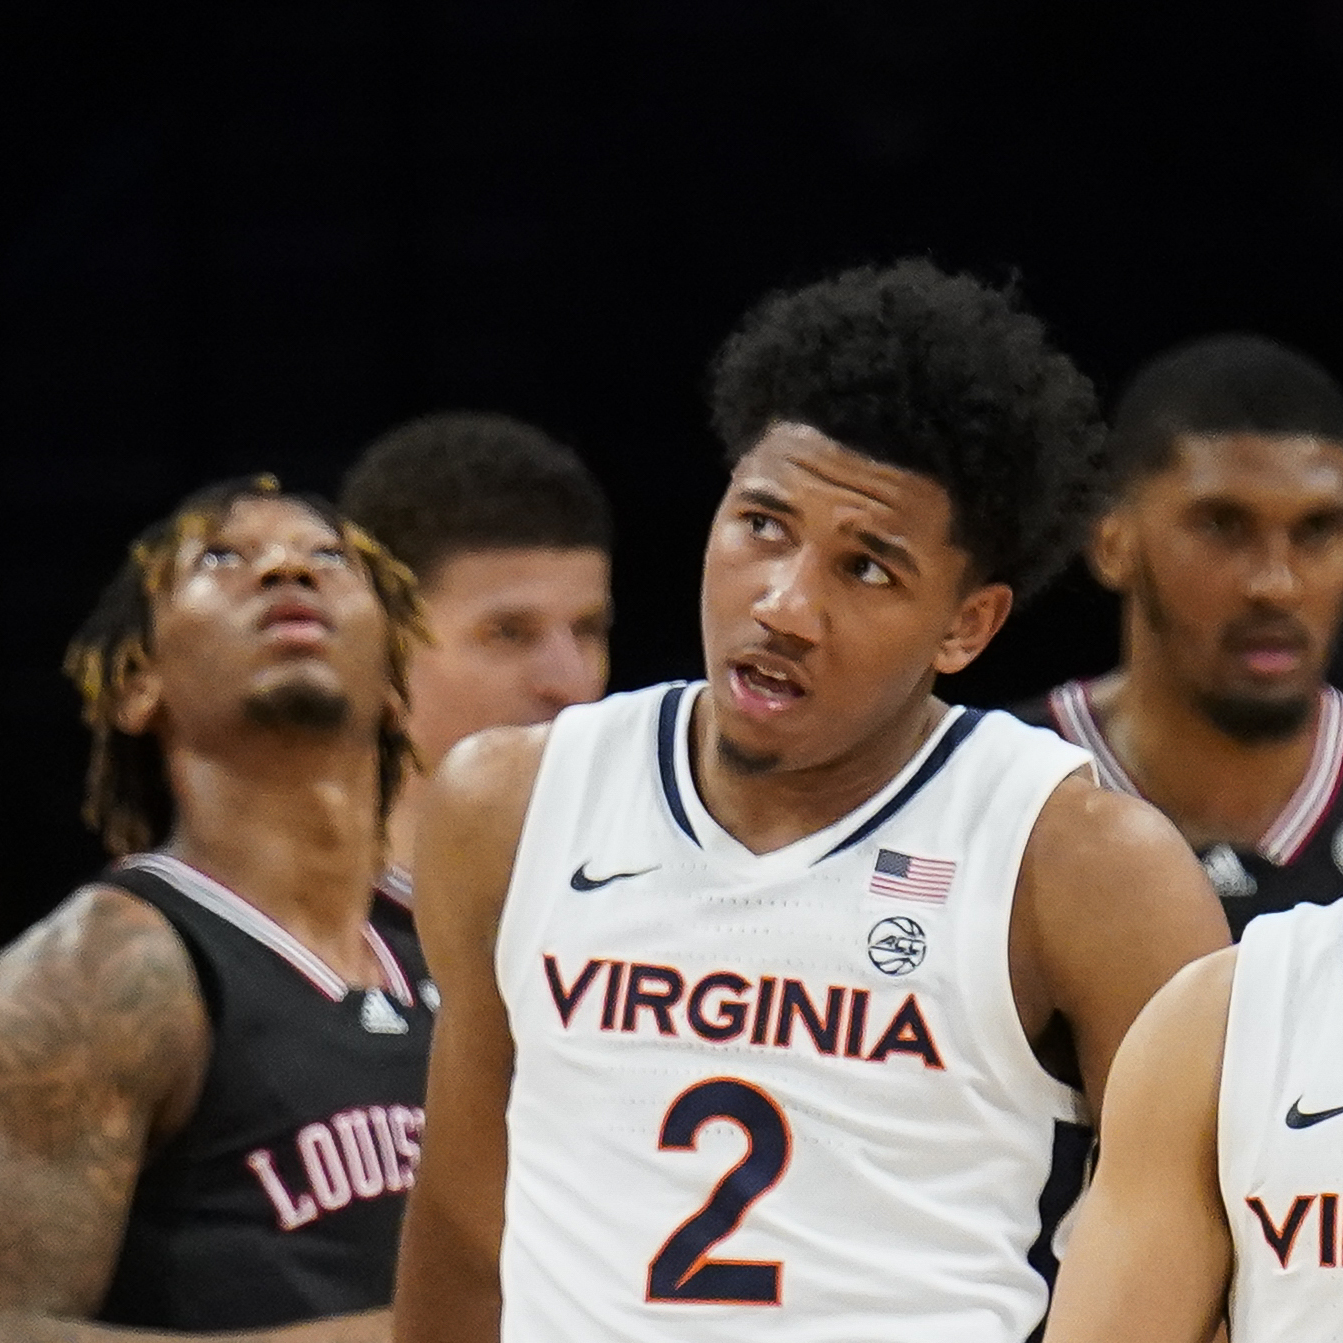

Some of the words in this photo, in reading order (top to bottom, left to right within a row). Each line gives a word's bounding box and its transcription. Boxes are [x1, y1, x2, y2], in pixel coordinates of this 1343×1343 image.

[542, 953, 946, 1071] VIRGINIA
[246, 1104, 426, 1232] LOUIS
[645, 1076, 793, 1307] 2
